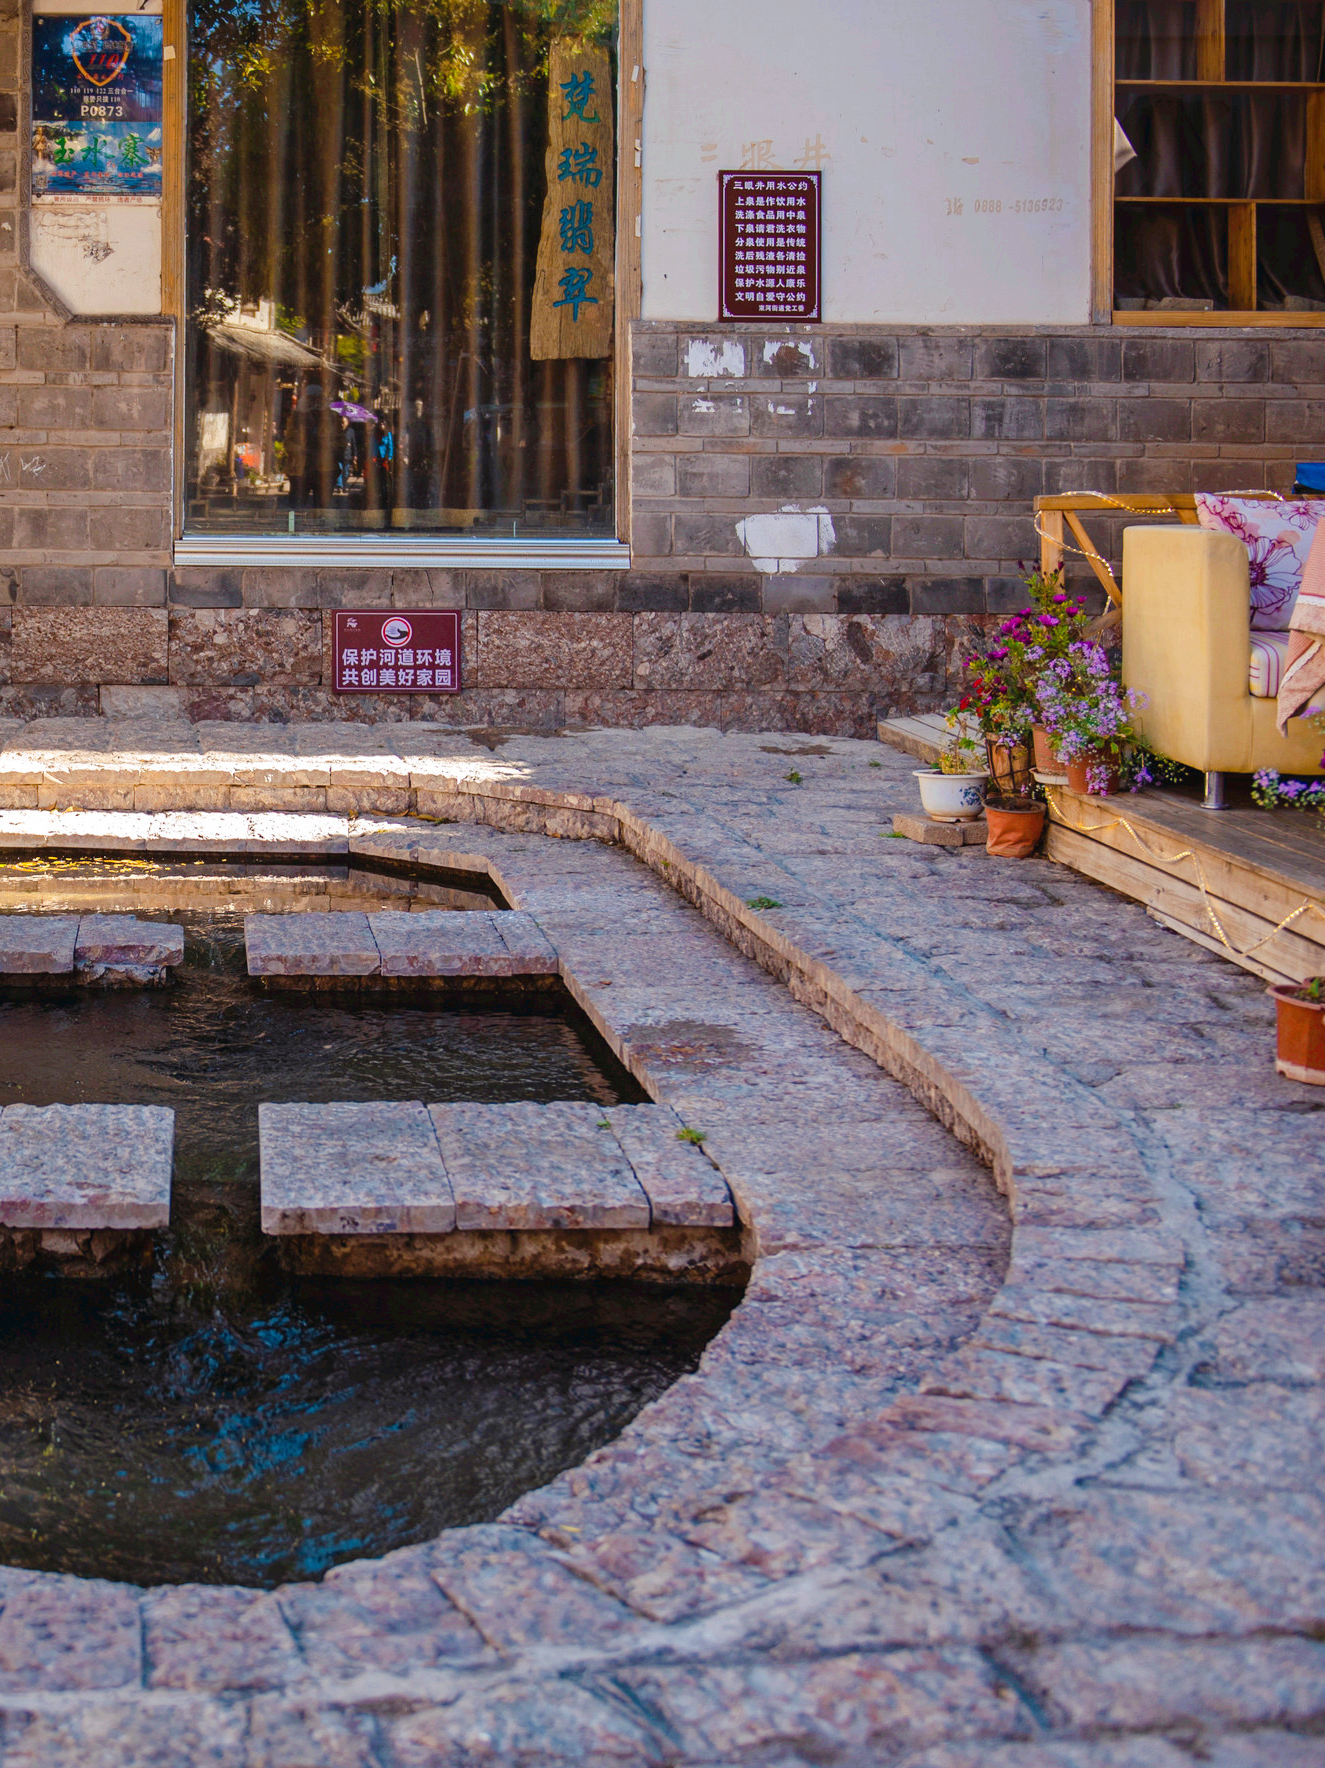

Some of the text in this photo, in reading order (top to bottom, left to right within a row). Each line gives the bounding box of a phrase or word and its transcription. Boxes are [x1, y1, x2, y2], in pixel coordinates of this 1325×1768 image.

[81, 105, 123, 117] P0873
[53, 133, 150, 168] 玉水寨
[733, 181, 808, 191] 三眼井用水公约
[734, 196, 806, 206] 上泉是作饮用水
[974, 199, 1002, 213] 0888
[342, 648, 452, 666] 保护河道环境
[342, 669, 452, 686] 共创美好家园
